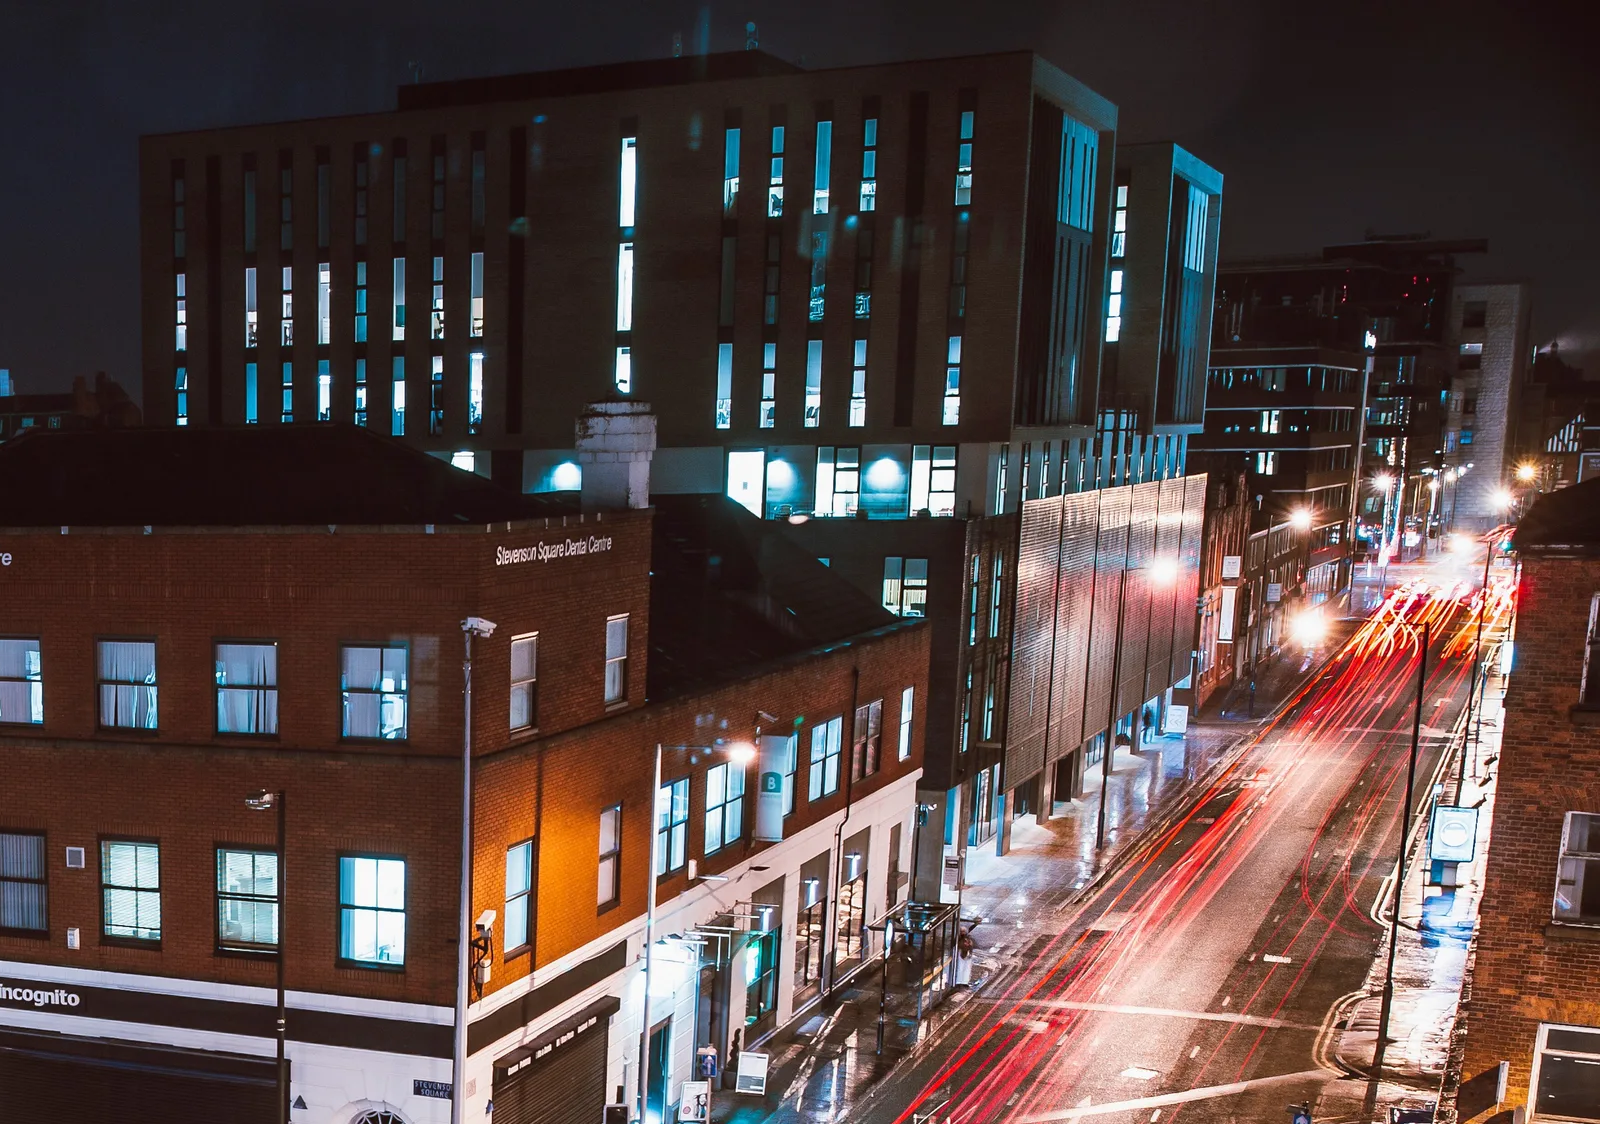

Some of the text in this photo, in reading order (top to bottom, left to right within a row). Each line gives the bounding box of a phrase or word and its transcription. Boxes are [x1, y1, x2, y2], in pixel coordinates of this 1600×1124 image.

[496, 536, 612, 566] Stevenson Square Dental Centre
[414, 1080, 453, 1092] STEVENSO
[420, 1088, 449, 1099] SQUARE
